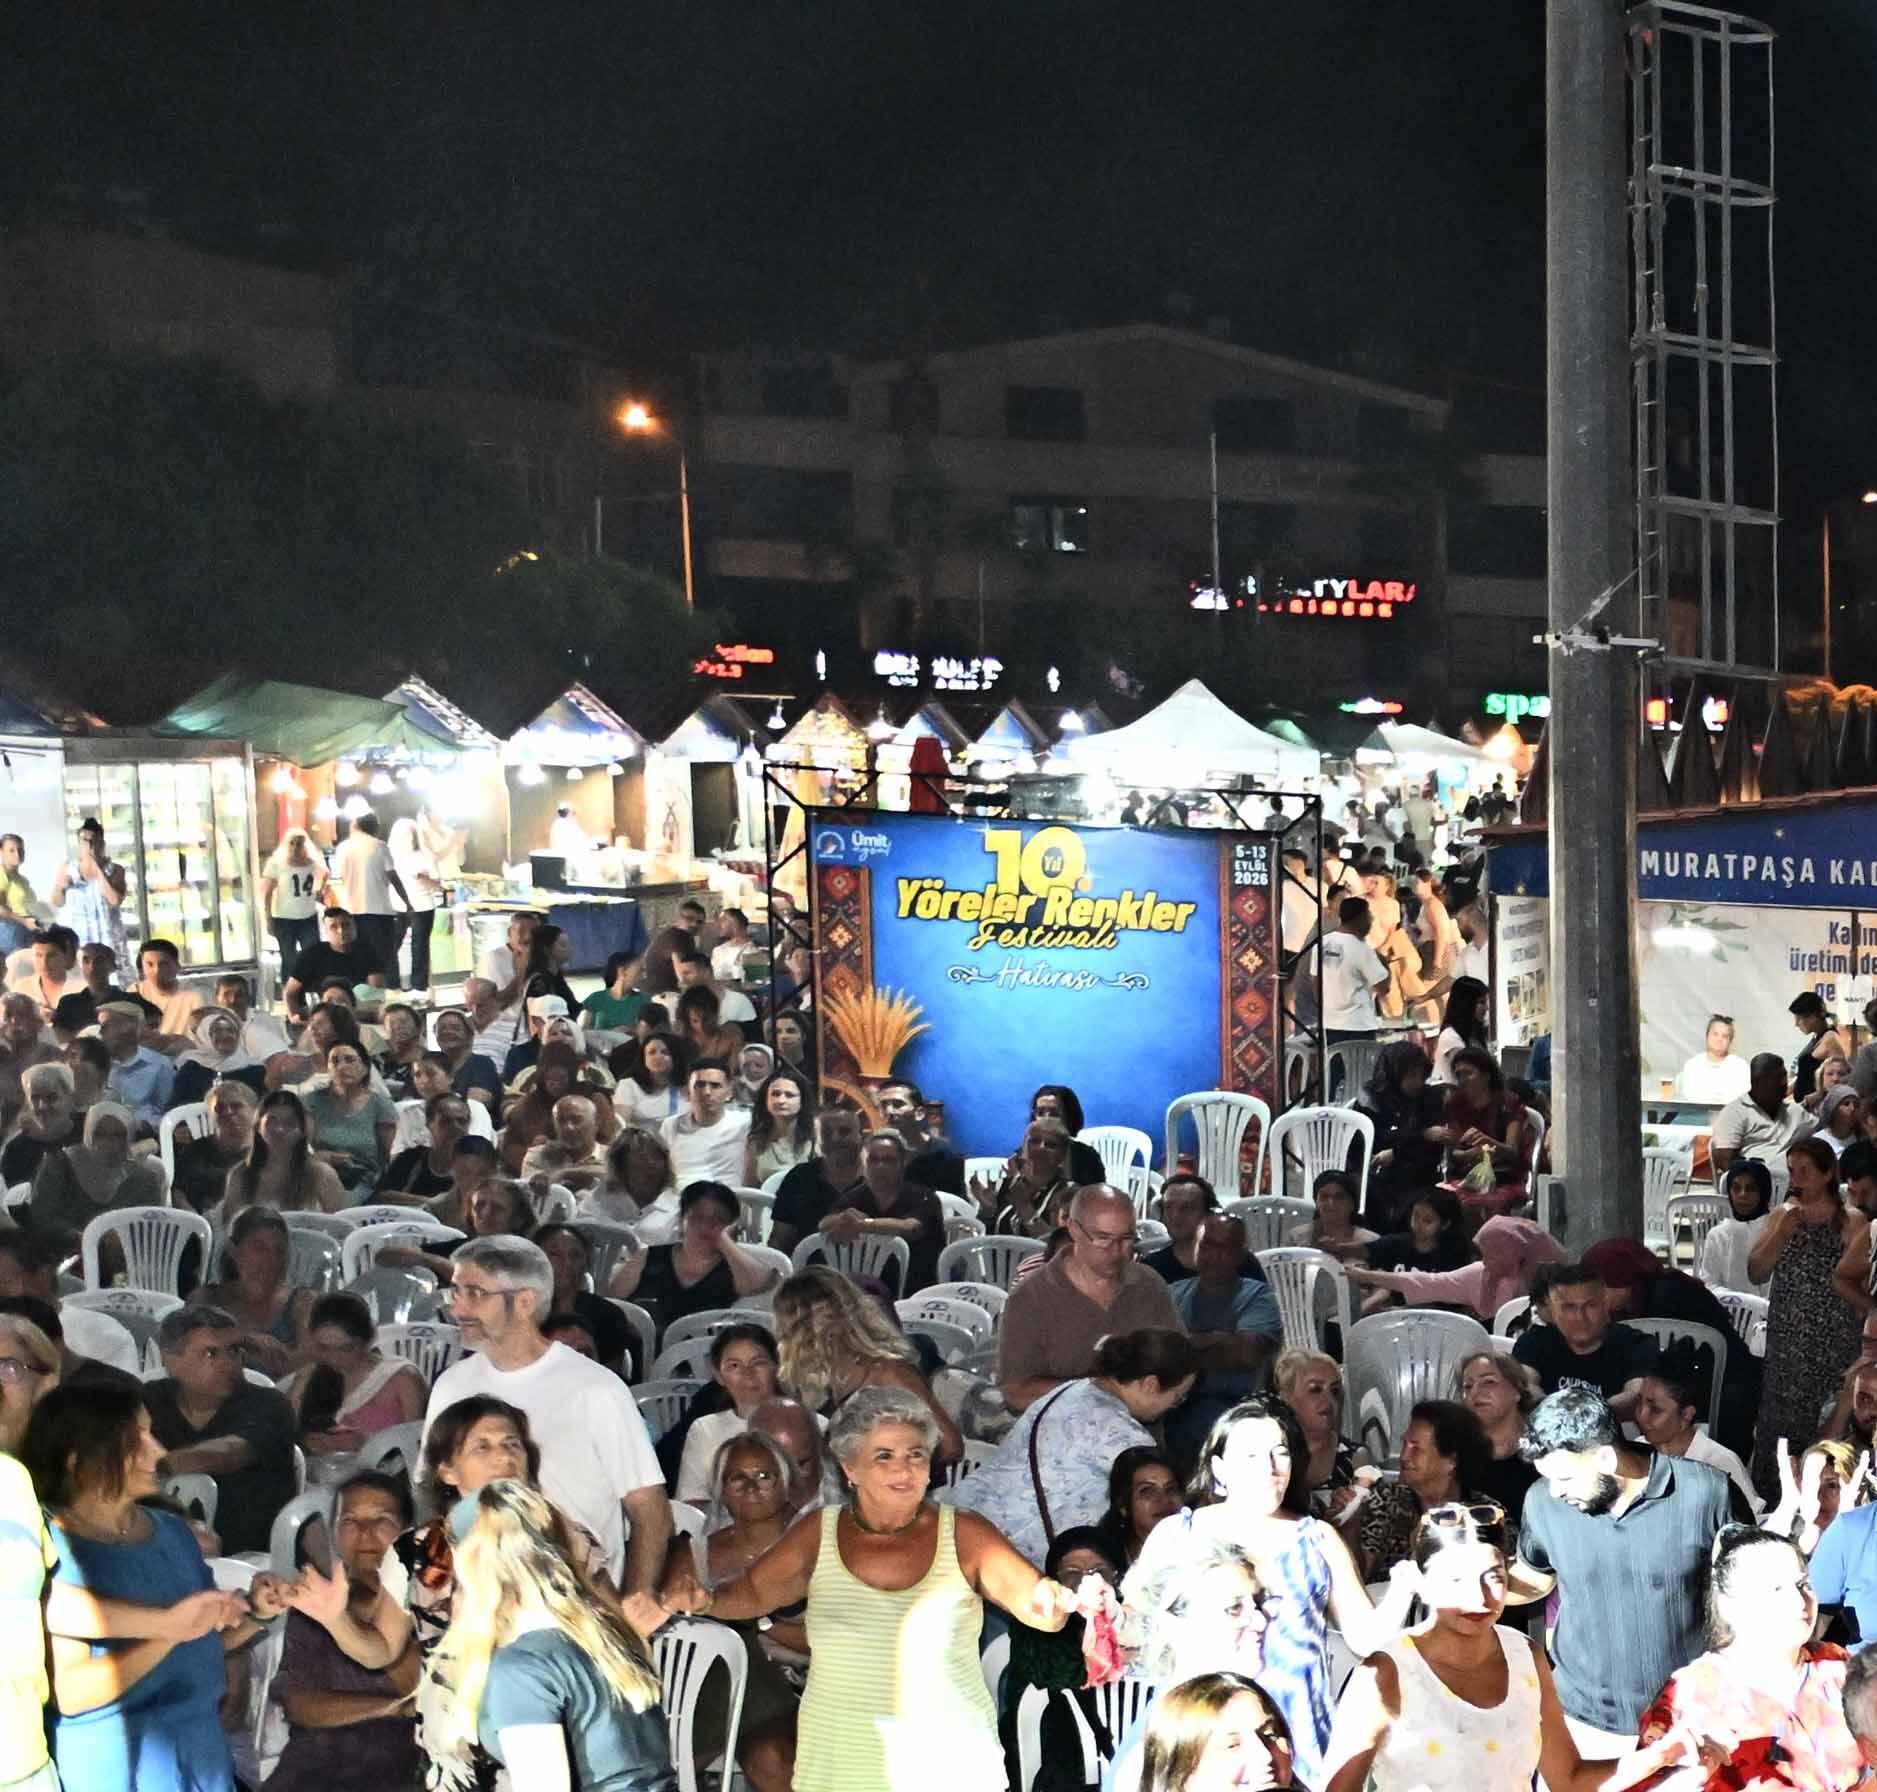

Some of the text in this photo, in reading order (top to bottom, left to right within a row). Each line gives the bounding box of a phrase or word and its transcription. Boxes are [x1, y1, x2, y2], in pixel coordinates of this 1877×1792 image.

[1233, 871, 1269, 886] 2026
[1234, 859, 1268, 872] EYLÜL
[1640, 849, 1816, 889] MURATPAŞA
[292, 873, 314, 897] 14
[897, 878, 1197, 932] Yöreler Renkler
[968, 917, 1122, 951] Festivali
[995, 954, 1100, 990] Hatırası
